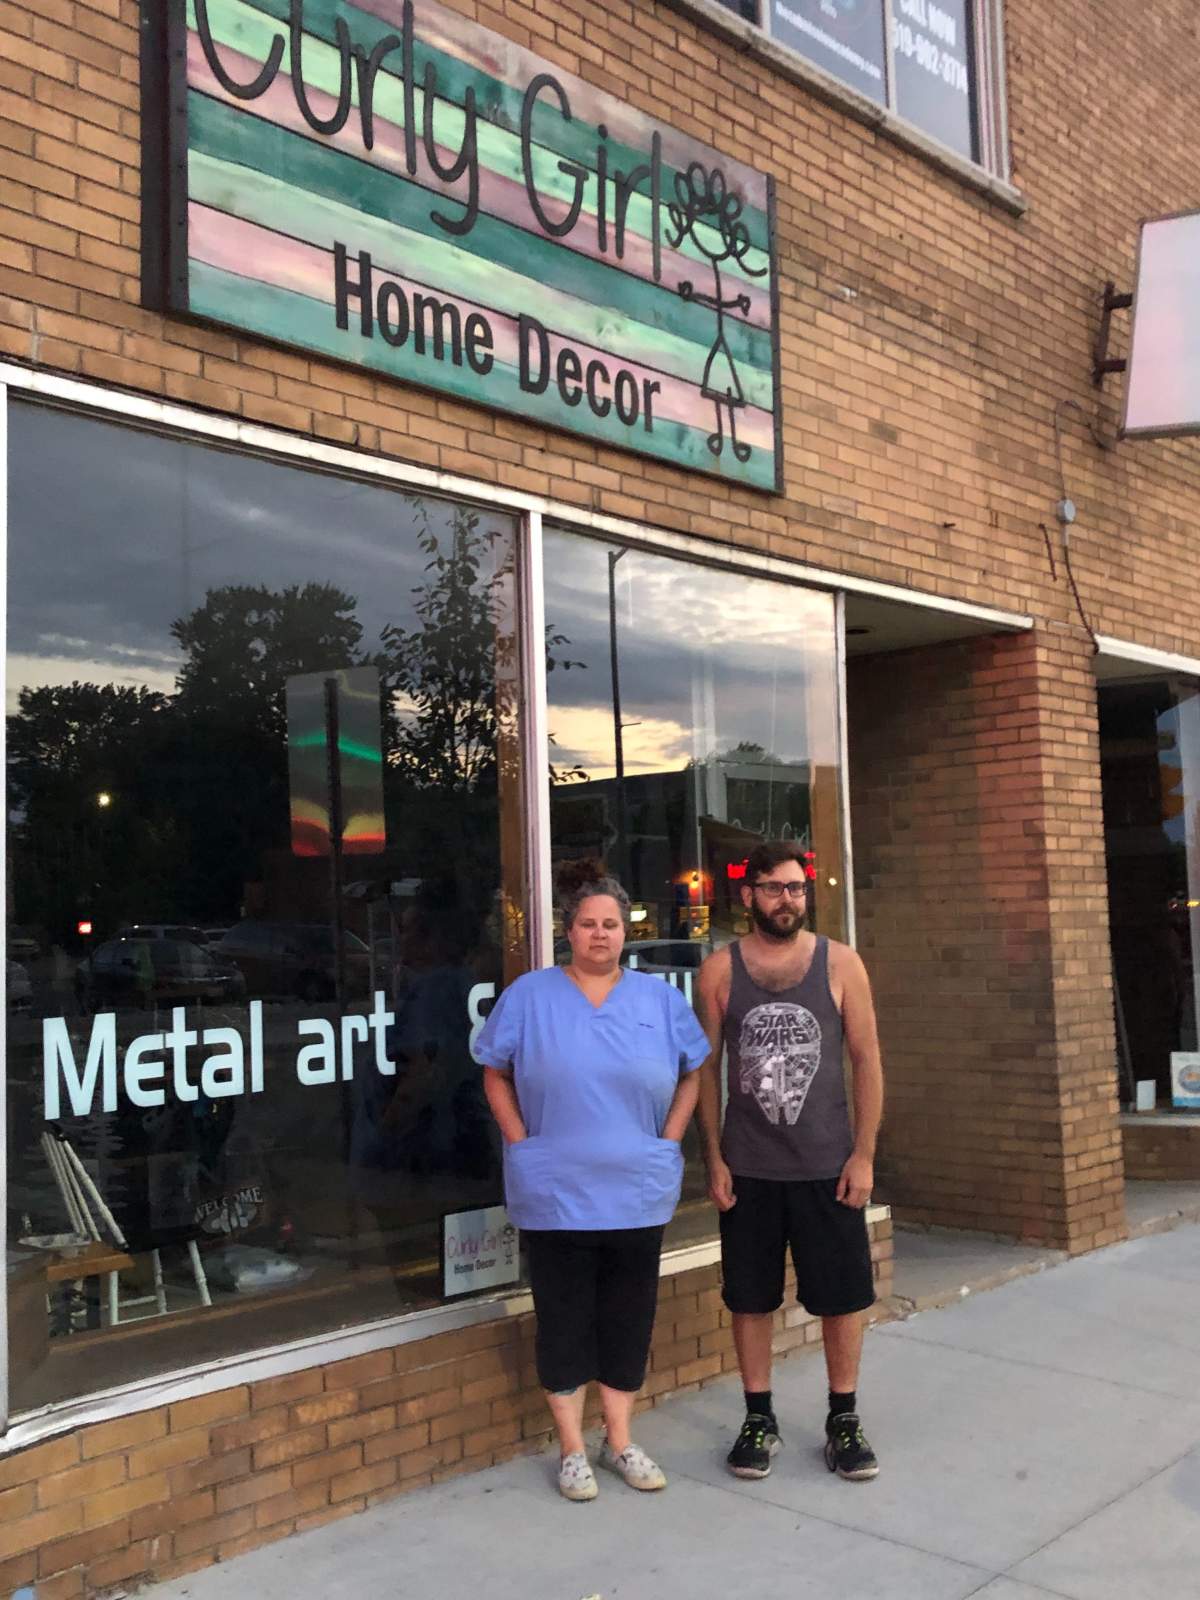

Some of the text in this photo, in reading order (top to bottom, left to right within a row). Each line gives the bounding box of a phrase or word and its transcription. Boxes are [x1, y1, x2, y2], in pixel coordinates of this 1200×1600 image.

[194, 0, 661, 282] Curly Girl
[333, 240, 661, 434] Home Decor
[42, 1000, 264, 1121] Metal
[296, 991, 397, 1086] art
[748, 1027, 811, 1047] WARS
[753, 1013, 799, 1029] STAR
